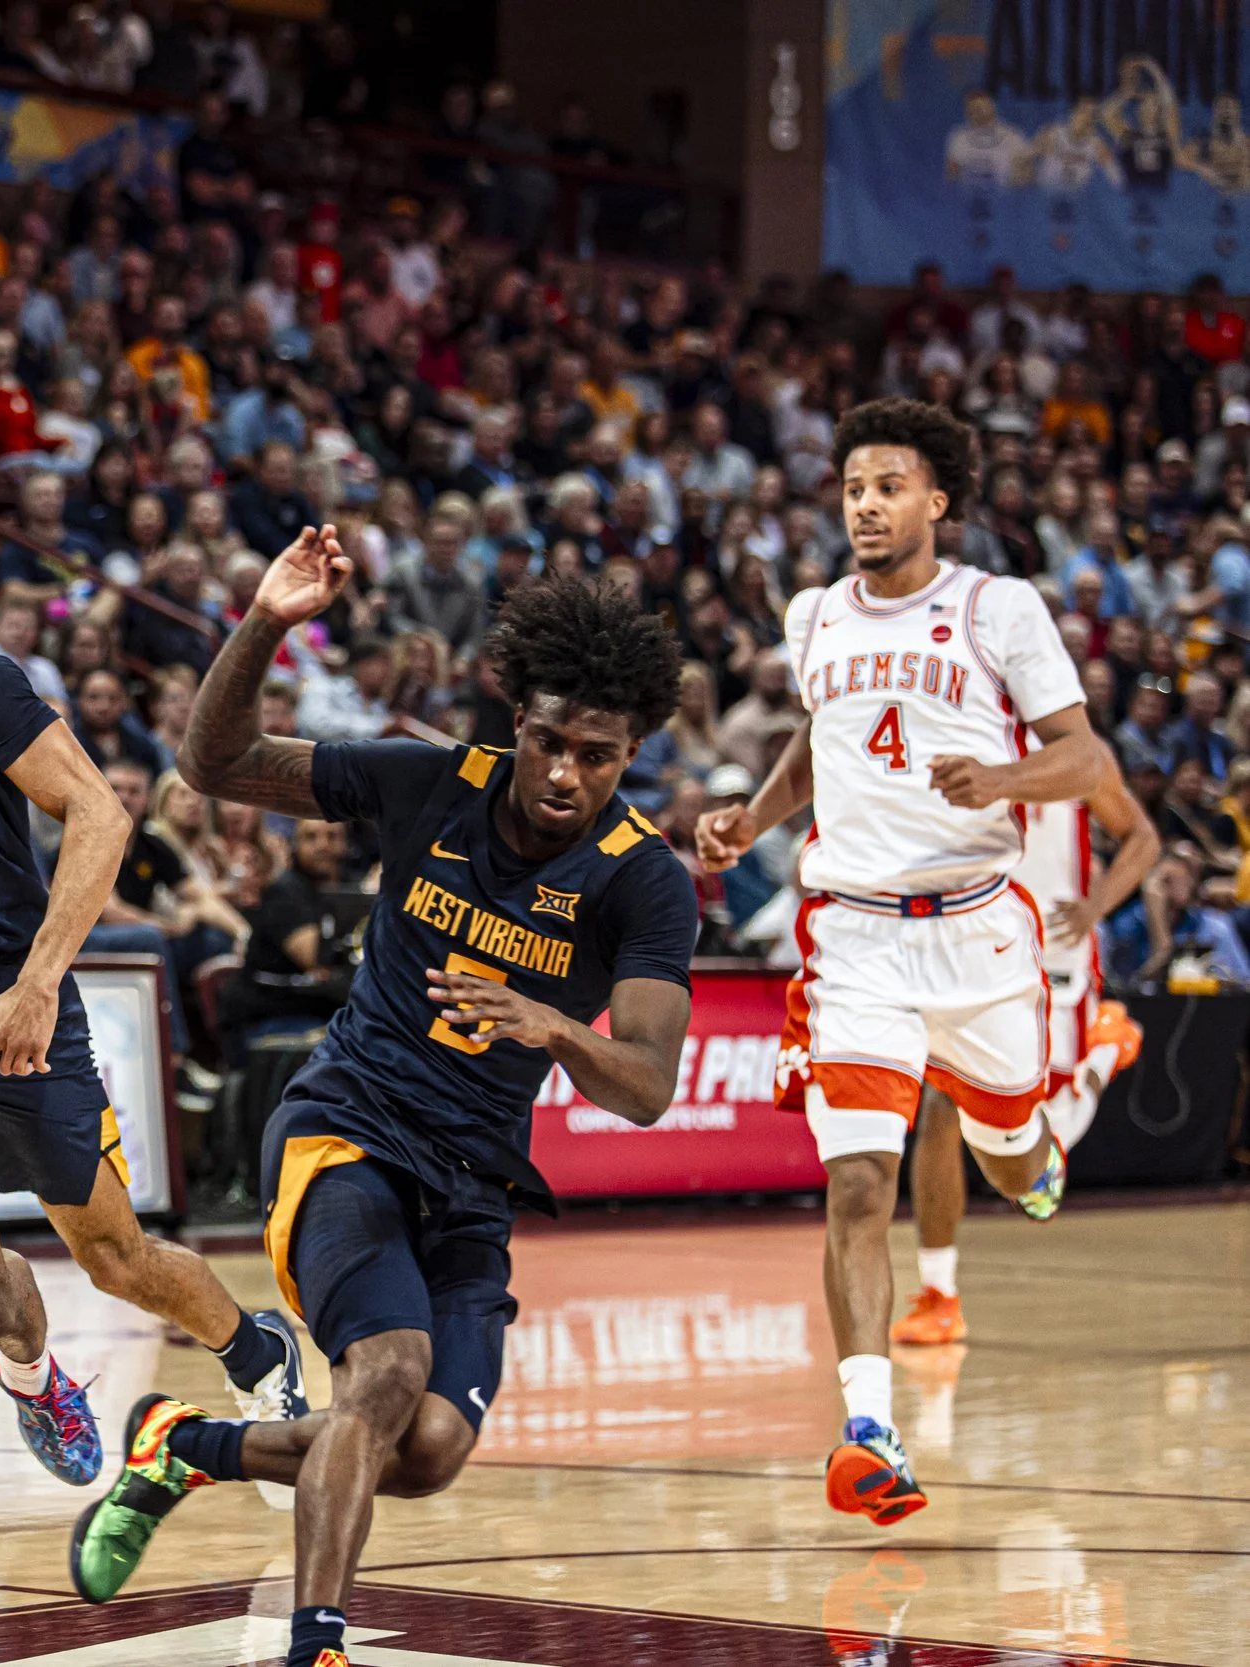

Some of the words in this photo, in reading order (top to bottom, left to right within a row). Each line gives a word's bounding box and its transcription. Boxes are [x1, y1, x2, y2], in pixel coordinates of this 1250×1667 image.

[808, 652, 969, 712] CLEMSON
[861, 700, 912, 775] 4
[402, 876, 472, 937] WEST
[466, 907, 575, 978] VIRGINIA
